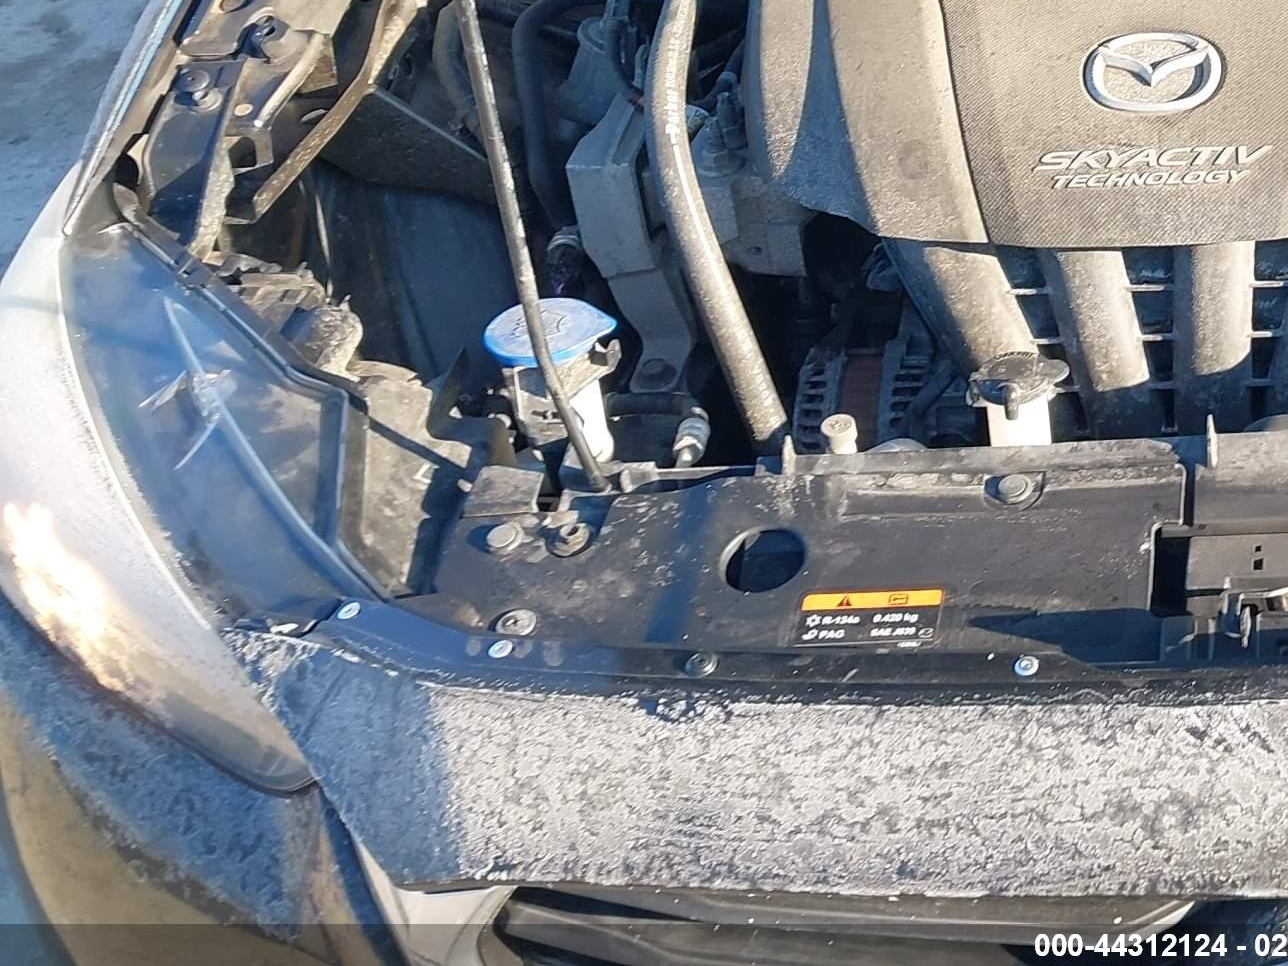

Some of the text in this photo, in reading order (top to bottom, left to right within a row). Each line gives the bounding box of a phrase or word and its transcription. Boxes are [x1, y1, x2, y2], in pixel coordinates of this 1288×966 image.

[1031, 144, 1273, 172] SKYACTIV
[1050, 169, 1249, 190] TECHNOLOGY
[903, 613, 919, 623] kg
[818, 629, 845, 639] PAG
